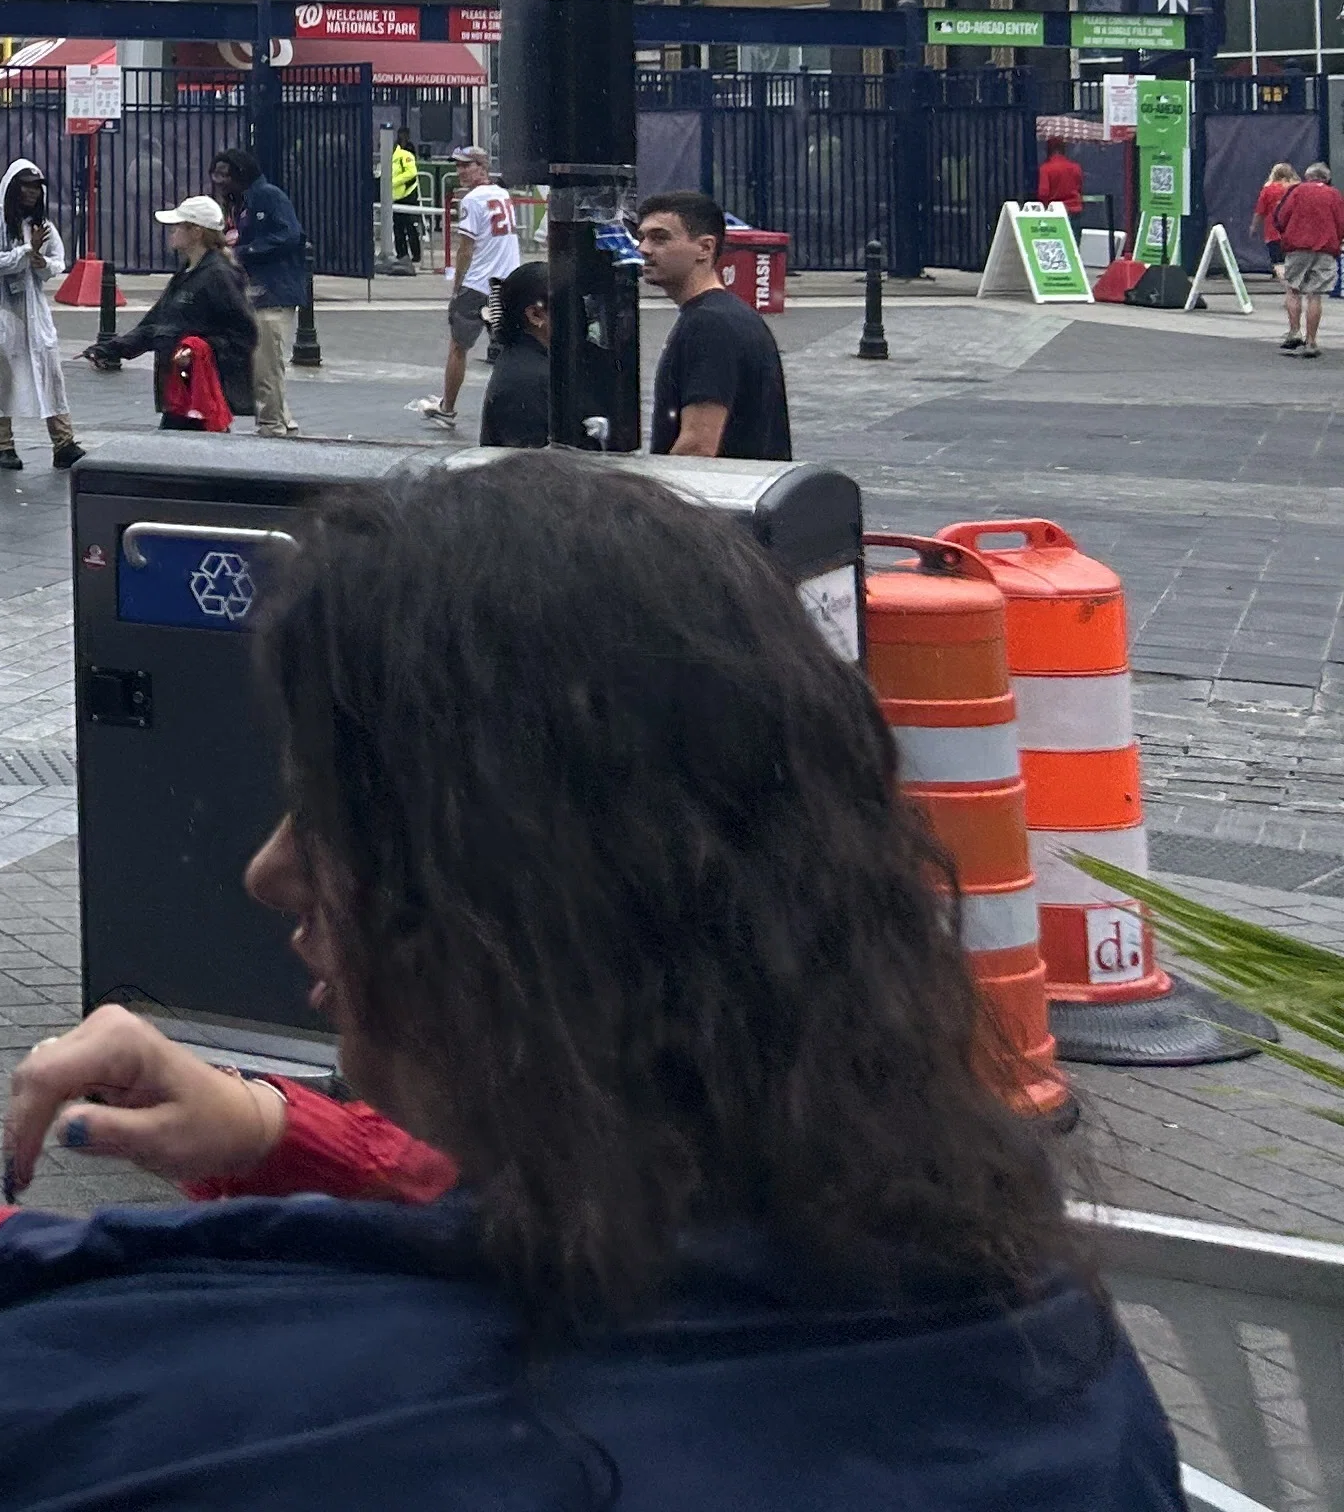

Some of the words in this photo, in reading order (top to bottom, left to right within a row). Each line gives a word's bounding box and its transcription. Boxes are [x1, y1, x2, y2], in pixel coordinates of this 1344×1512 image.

[326, 9, 379, 22] WELCOME
[382, 9, 396, 22] TO
[326, 21, 384, 35] NATIONALS
[387, 22, 416, 35] PARK
[956, 20, 1004, 34] GO-AHEAD
[1005, 21, 1038, 35] ENTRY
[372, 74, 394, 84] ASON
[756, 253, 771, 310] TRASH
